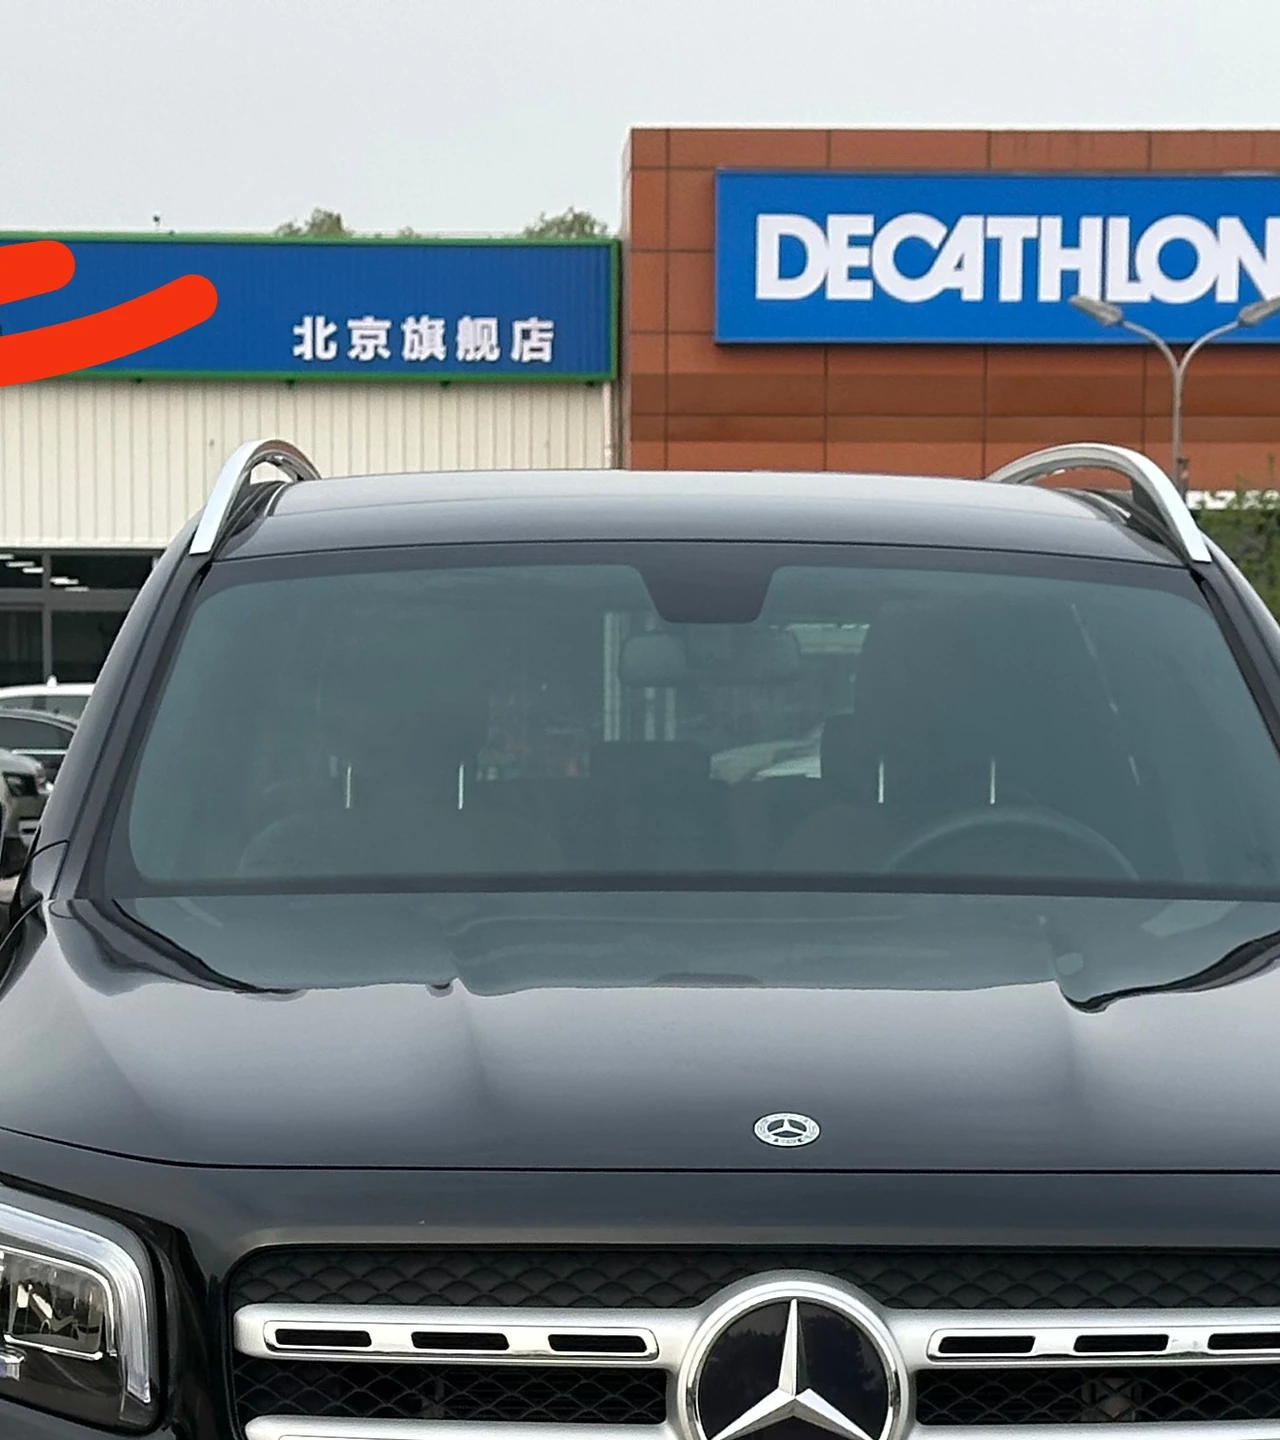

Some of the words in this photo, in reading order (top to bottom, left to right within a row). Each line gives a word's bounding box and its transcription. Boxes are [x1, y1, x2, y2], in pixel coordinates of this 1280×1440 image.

[292, 315, 555, 363] 北京旗舰店
